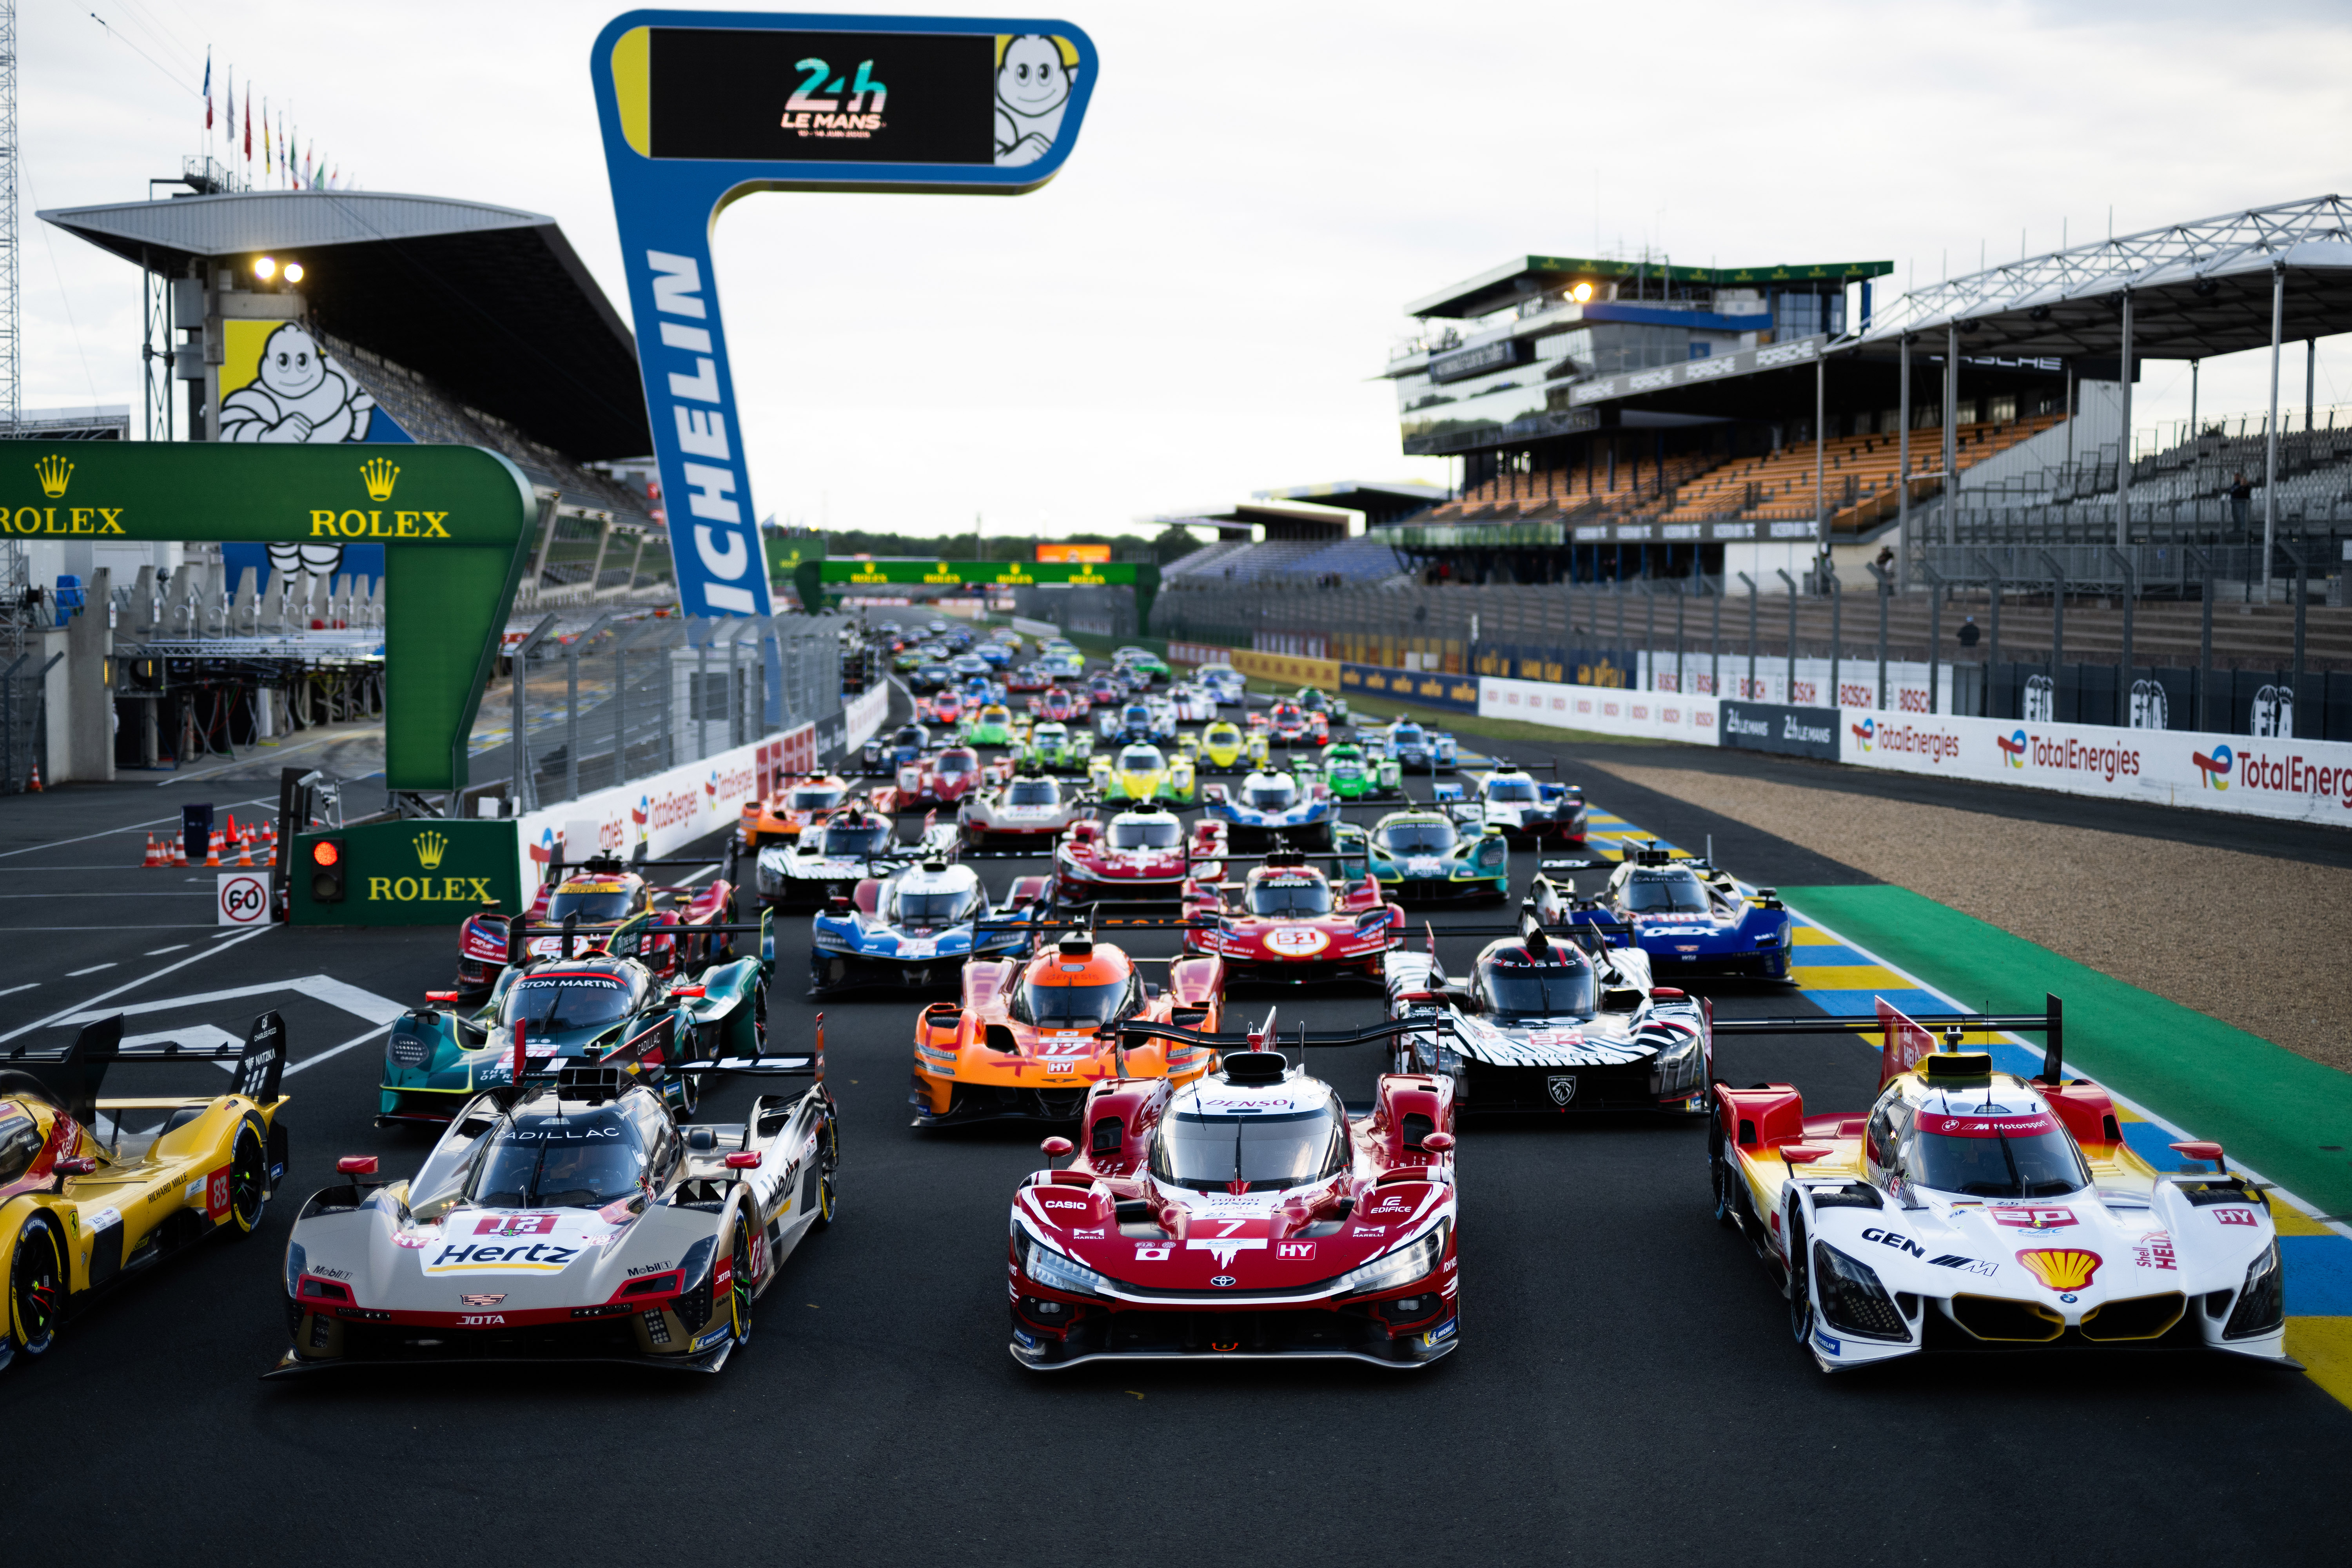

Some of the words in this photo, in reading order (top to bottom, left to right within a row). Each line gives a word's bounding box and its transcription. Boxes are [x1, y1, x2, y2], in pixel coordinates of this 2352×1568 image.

[784, 57, 887, 112] 24h
[780, 112, 811, 128] LE
[813, 113, 881, 130] MANS
[309, 510, 451, 538] ROLEX
[1740, 678, 1765, 699] BOCH
[1793, 681, 1816, 704] OSCH
[1841, 683, 1872, 708] BOSCH
[1662, 708, 1680, 723] BOSCH
[1695, 711, 1713, 727] BOSCH
[1726, 708, 1740, 733] 24h
[1739, 718, 1748, 733] LE
[1749, 720, 1769, 737] MANS
[1783, 714, 1798, 740] 24h
[1797, 724, 1808, 741] LE
[1808, 726, 1831, 744] MANS
[1877, 722, 1960, 763] TotalEnergies
[2030, 735, 2140, 783] TotalEnergies
[717, 761, 755, 801] TotalEnergies
[650, 786, 698, 833] TotalEnergies
[1542, 859, 1591, 867] DEX
[368, 876, 493, 902] ROLEX
[228, 889, 260, 910] 60
[1279, 933, 1316, 944] 51
[1643, 927, 1721, 937] DEX
[469, 946, 495, 958] RICHARD
[1492, 957, 1586, 968] PEUGEOT
[559, 980, 617, 989] MARTIN
[254, 1031, 268, 1042] CHARLES
[268, 1027, 277, 1038] POZZI
[1530, 1033, 1582, 1044] 94
[1904, 1026, 1912, 1044] Shell
[637, 1032, 660, 1056] CADILLAC
[1045, 1043, 1086, 1054] 17
[255, 1047, 276, 1067] NATZKA
[1050, 1063, 1072, 1072] HY
[1993, 1120, 2049, 1130] Motorsport
[494, 1127, 620, 1140] CADILLAC
[147, 1182, 171, 1204] RICHARD
[171, 1172, 188, 1189] MILLE
[213, 1174, 228, 1210] 83
[1045, 1201, 1087, 1210] CASIO
[1949, 1209, 1967, 1218] FIA
[1993, 1210, 2073, 1221] 20
[2215, 1210, 2249, 1222] HY
[27, 1218, 47, 1230] MICHELIN
[488, 1216, 544, 1233] 12
[1216, 1220, 1246, 1237] 7
[393, 1233, 426, 1247] HY
[1861, 1227, 1926, 1259] GEN
[431, 1243, 580, 1265] Hertz
[1279, 1245, 1313, 1257] HY
[2132, 1247, 2152, 1268] Shell
[2140, 1229, 2178, 1270] HELIX
[313, 1265, 342, 1278] Mobil
[627, 1263, 661, 1277] Mobil
[715, 1270, 731, 1285] JOTA
[456, 1315, 505, 1325] JOTA
[704, 1327, 728, 1345] MICHELIN
[1437, 1321, 1455, 1338] MICHELIN
[26, 1342, 48, 1353] MICHELIN
[1816, 1334, 1836, 1350] MICHELIN
